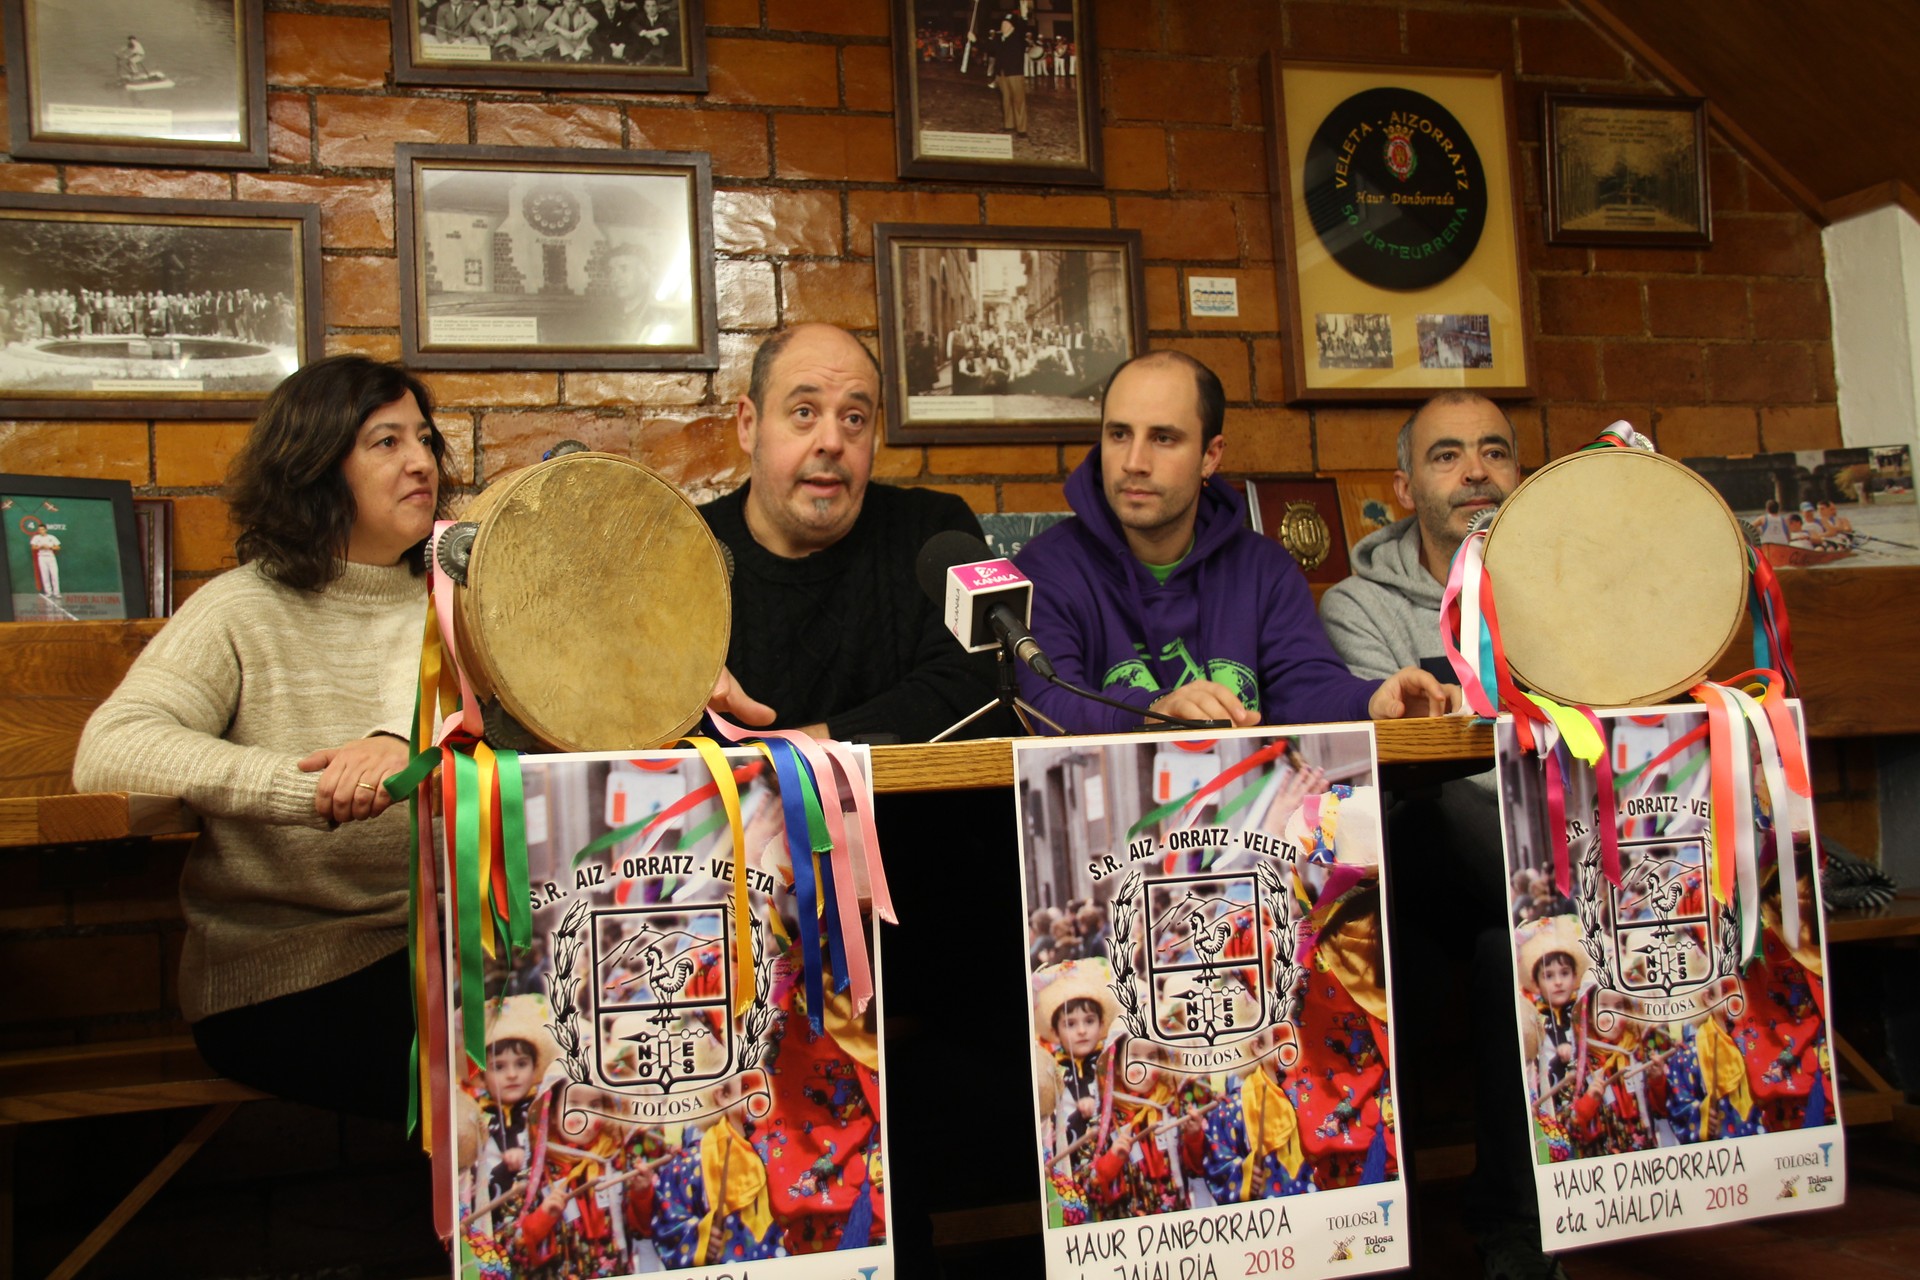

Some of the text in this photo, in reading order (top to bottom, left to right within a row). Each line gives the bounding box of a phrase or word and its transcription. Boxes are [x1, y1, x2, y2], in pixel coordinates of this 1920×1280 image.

[1335, 122, 1374, 189] VELETA
[1390, 111, 1470, 190] AIZORRATZ
[1356, 190, 1455, 205] Haur Danborrada
[1362, 208, 1468, 260] URTEURRENA
[973, 573, 1019, 587] KANALA
[1627, 796, 1678, 816] ORRATZ
[1089, 855, 1123, 880] S.R.
[1129, 838, 1154, 861] AIZ
[1169, 829, 1228, 850] ORRATZ
[1244, 831, 1297, 863] VELETA
[575, 864, 605, 889] AIZ
[623, 855, 694, 879] ORRATZ
[711, 859, 775, 895] VEETA
[1646, 952, 1686, 968] N E
[1647, 966, 1687, 983] O S
[1186, 998, 1233, 1016] N E
[1644, 998, 1695, 1016] TOLOSA
[1187, 1013, 1234, 1031] O S
[638, 1041, 694, 1060] N E
[1182, 1047, 1242, 1067] TOLOSA
[638, 1058, 695, 1077] O S
[632, 1096, 703, 1117] TOLOSA
[1553, 1165, 1606, 1200] HAUR
[1613, 1146, 1745, 1192] DANBORRADA
[1807, 1175, 1832, 1185] Tolosa
[1556, 1207, 1587, 1234] eta
[1705, 1183, 1748, 1211] 2018
[1065, 1228, 1127, 1266] HAUR
[1137, 1205, 1291, 1257] DANBORRADA
[1364, 1235, 1394, 1246] Tolosa
[1244, 1246, 1295, 1276] 2018
